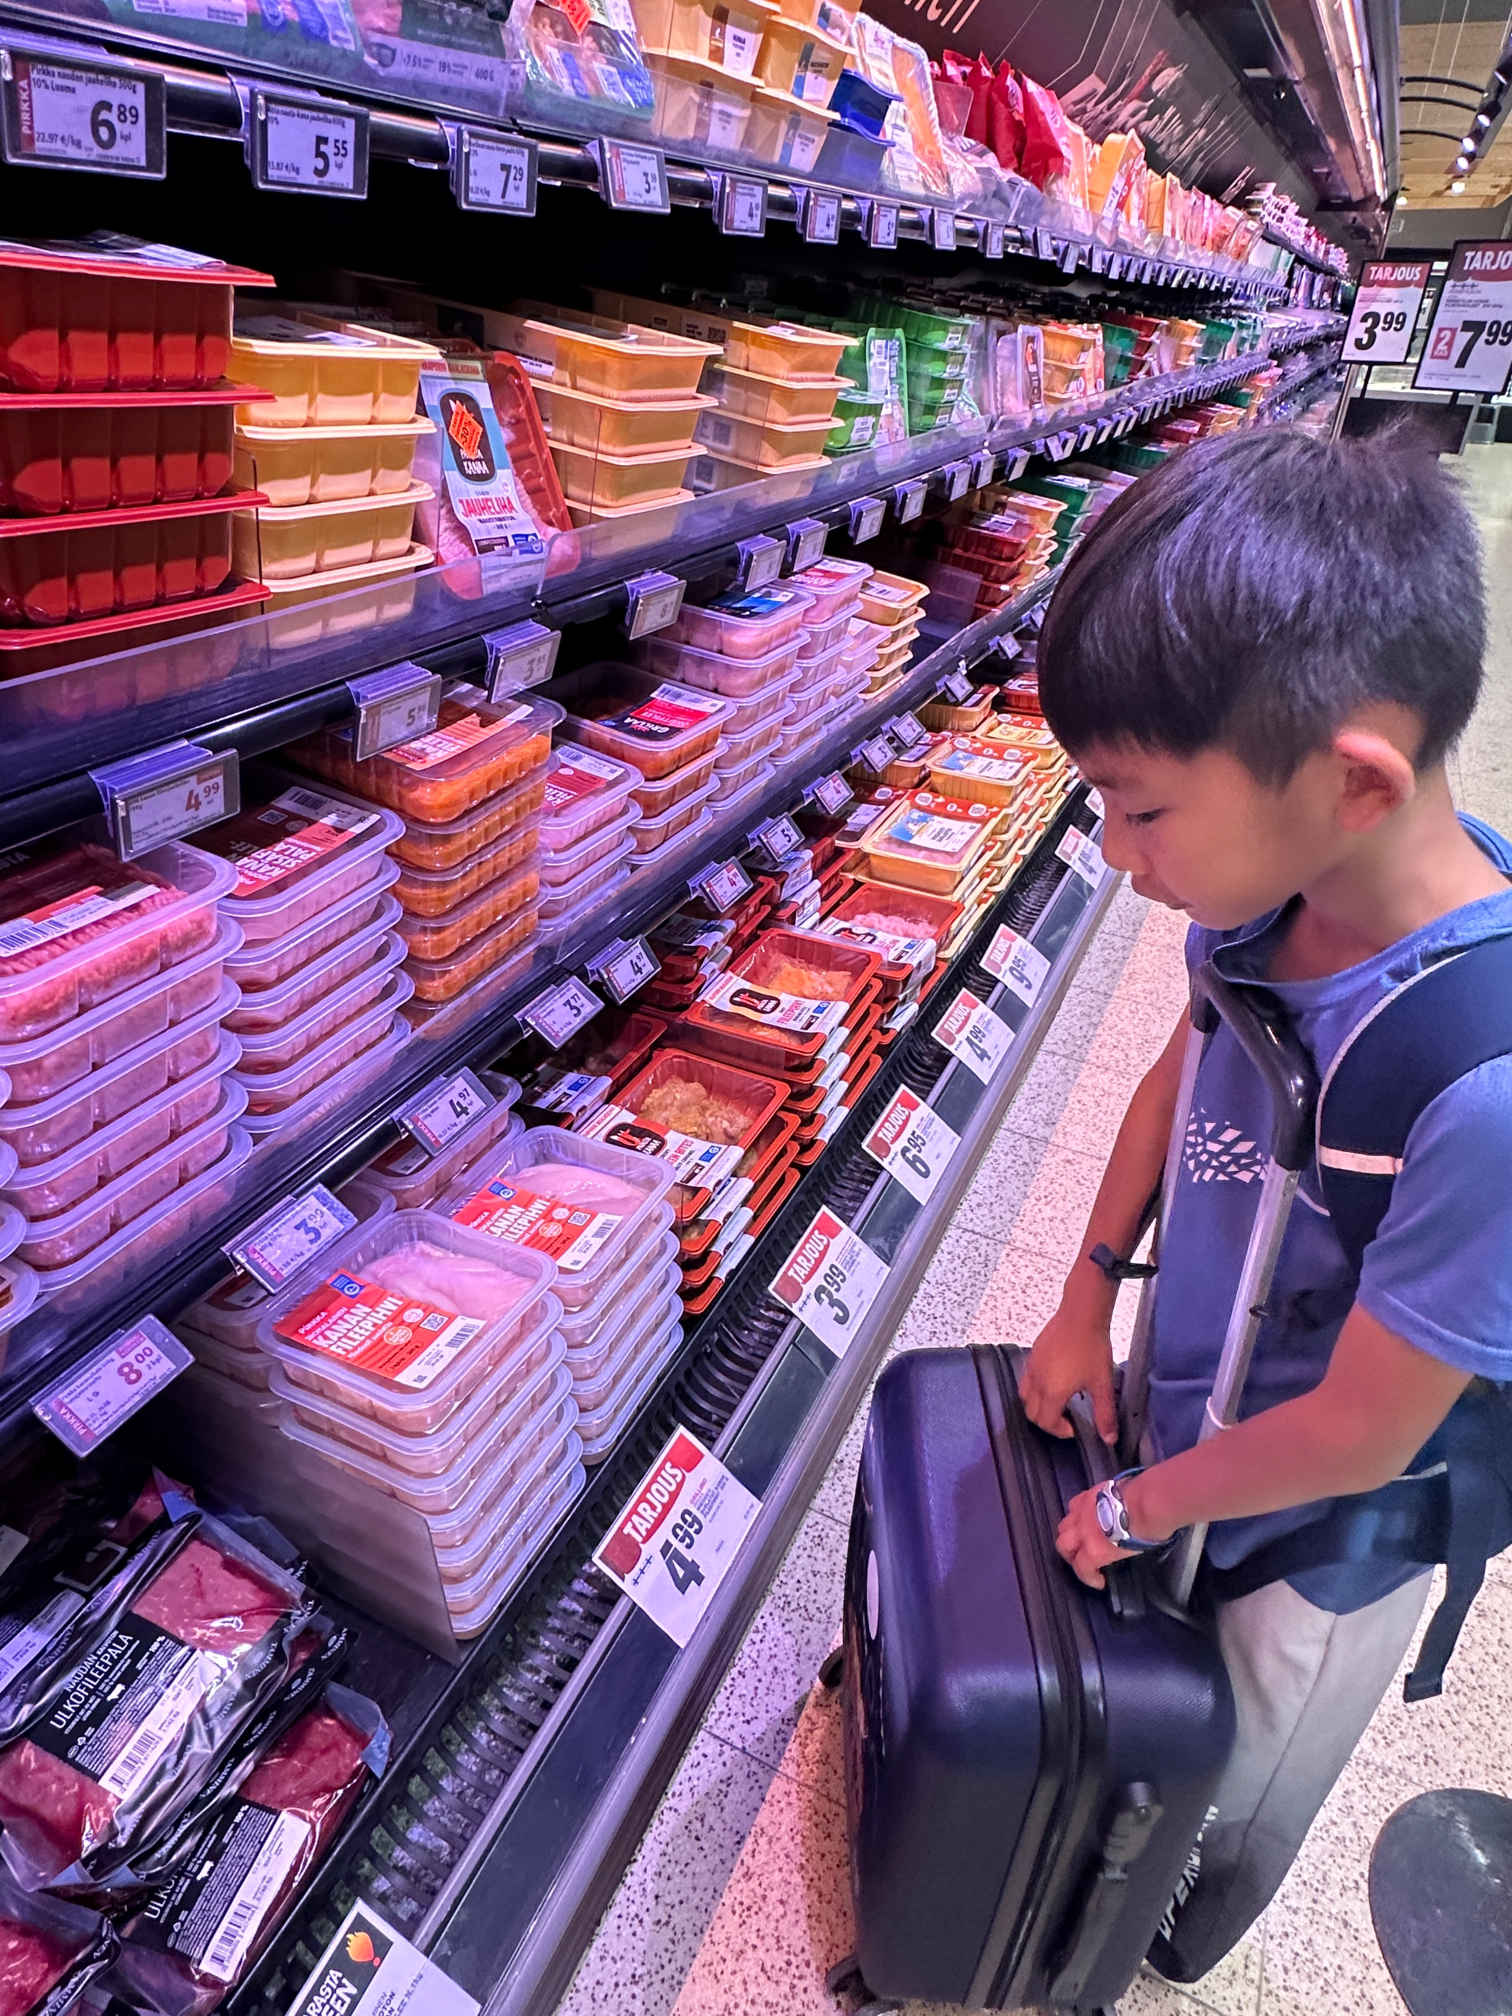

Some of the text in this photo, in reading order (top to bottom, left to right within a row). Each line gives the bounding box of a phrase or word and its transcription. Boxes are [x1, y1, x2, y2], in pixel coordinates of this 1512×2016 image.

[30, 65, 56, 79] Pirkka
[85, 75, 117, 90] jauheliha
[32, 77, 76, 96] 10% Luomu
[21, 79, 33, 136] PIRKKA
[35, 131, 59, 145] 22.97
[120, 131, 131, 145] kpl
[1369, 267, 1421, 281] TARJOUS
[458, 496, 517, 518] JAUHELIHA
[946, 1004, 970, 1035] TARJOUS
[416, 1121, 436, 1143] PIRKKA
[877, 1105, 909, 1143] TARJOUS
[678, 1139, 695, 1158] BITES
[500, 1198, 550, 1242] ILEEPIHVI
[251, 1252, 277, 1277] PIRKKA
[788, 1229, 828, 1282] TARJOUS
[298, 1311, 328, 1334] PIRKKA
[304, 1306, 348, 1341] SUOMALAINEN
[312, 1303, 373, 1348] KANAN
[329, 1295, 404, 1355] FILEEPIHVI
[151, 1355, 163, 1367] kpl
[61, 1388, 76, 1401] Pirkka
[60, 1406, 88, 1436] PIRKKA
[623, 1461, 682, 1544] TARJOUS
[320, 1627, 348, 1662] AMMINEN
[65, 1653, 98, 1692] NAUDAN
[245, 1641, 278, 1681] TAMMINEN
[50, 1633, 133, 1730] ULKOFILEEPALA
[284, 1667, 315, 1701] TAMMINEN
[200, 1758, 235, 1798] TAMMINEN
